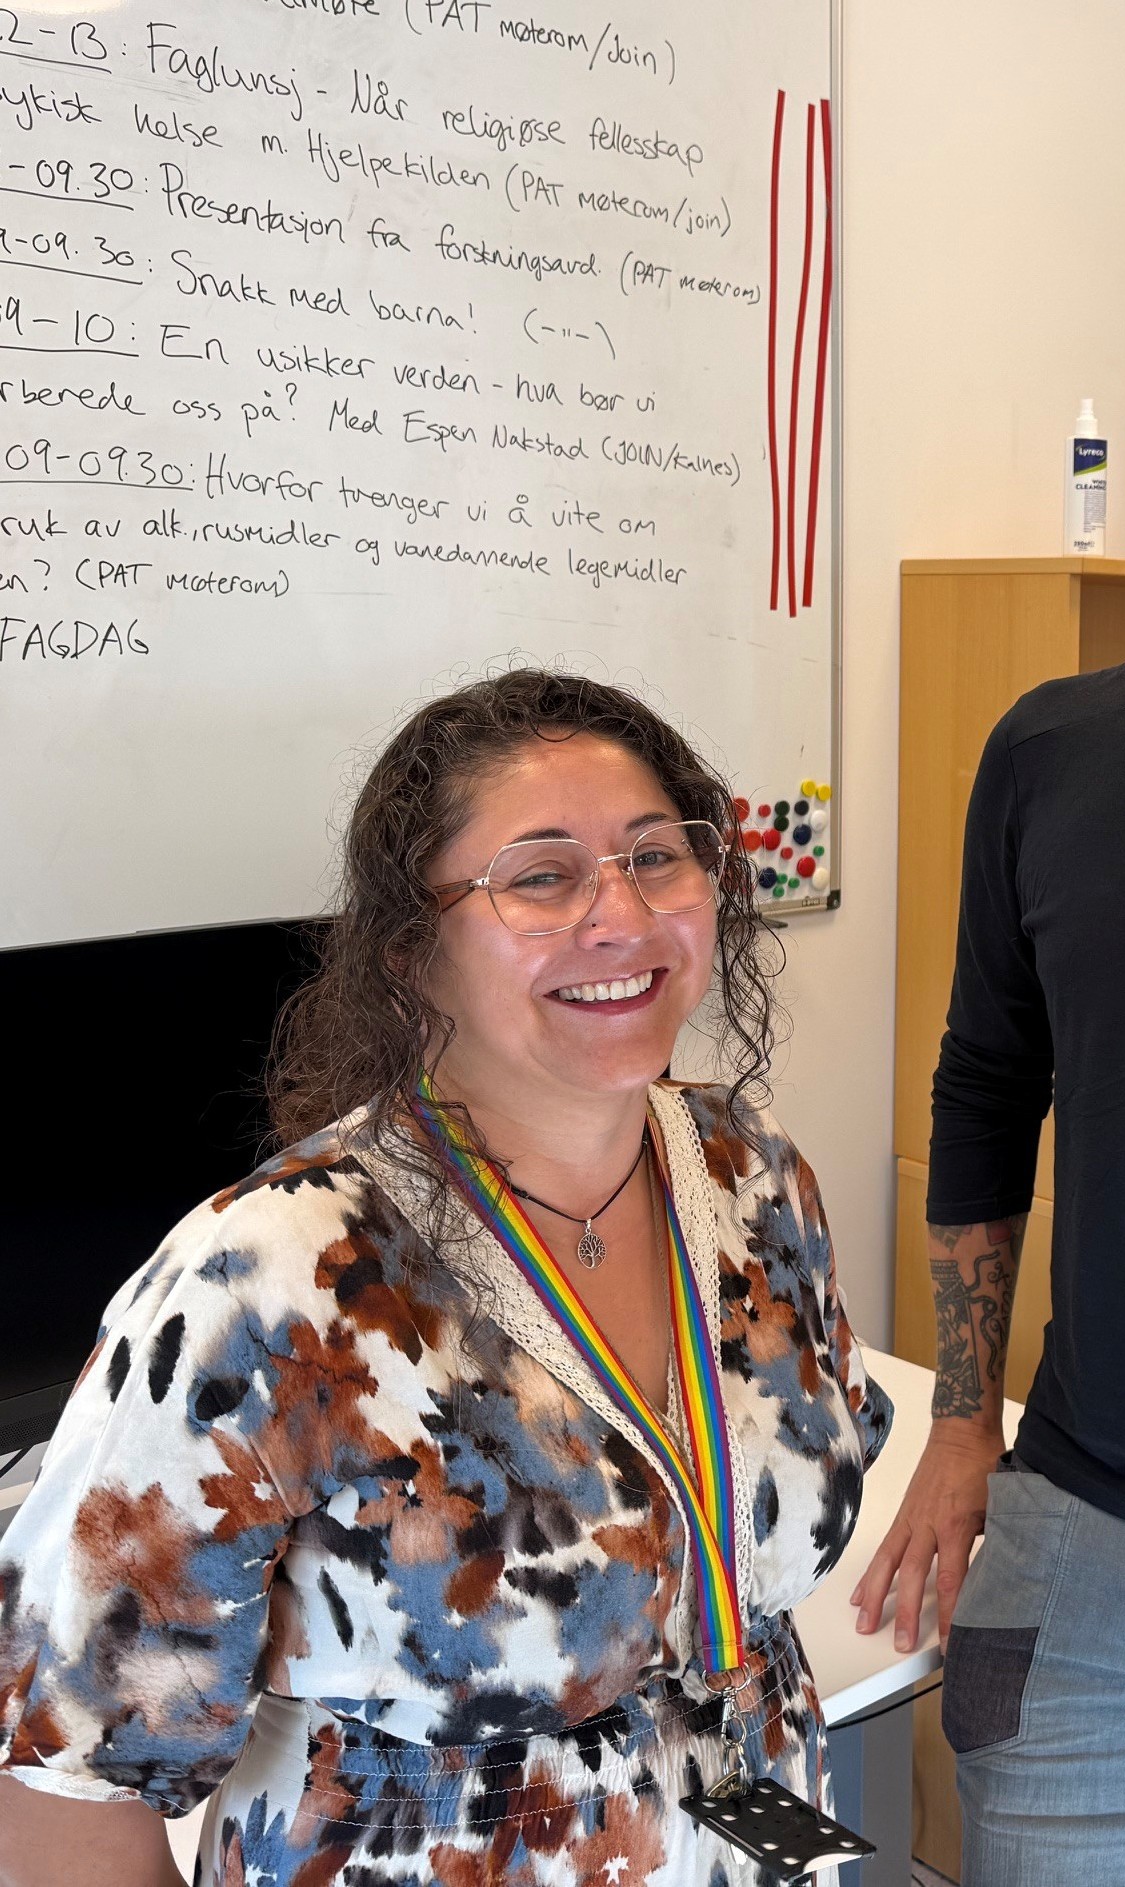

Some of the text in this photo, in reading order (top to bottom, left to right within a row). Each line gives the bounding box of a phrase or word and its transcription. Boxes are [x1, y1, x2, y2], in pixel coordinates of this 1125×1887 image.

[146, 22, 302, 121] Faglunsj
[351, 69, 408, 121] Når
[442, 105, 566, 152] religiøse
[589, 117, 703, 178] fellesskap
[0, 84, 102, 131] ykisk
[135, 104, 223, 148] helse
[262, 135, 288, 154] m.
[308, 128, 490, 190] Hjelpekilden
[505, 163, 564, 212] (PAT
[159, 162, 345, 244] Presentasjon
[366, 217, 411, 252] fra
[620, 251, 672, 296] (PAT
[171, 250, 276, 305] Snakk
[290, 288, 350, 316] med
[370, 290, 476, 334] barna!
[160, 324, 229, 365] En
[257, 345, 375, 379] usikker
[394, 365, 480, 394] verden
[517, 373, 563, 405] hva
[580, 383, 624, 411] bør
[637, 391, 655, 411] vi
[173, 400, 221, 421] oss
[241, 382, 297, 438] på?
[329, 397, 383, 435] Med
[403, 410, 477, 453] Espen
[492, 425, 589, 460] Nakstad
[206, 452, 323, 502] Hvorfor
[339, 476, 450, 524] trenger
[468, 501, 487, 522] vi
[508, 494, 532, 527] å
[552, 500, 604, 533] vite
[619, 519, 655, 536] om
[75, 558, 153, 590] (PAT
[85, 520, 121, 537] av
[355, 539, 379, 566] og
[395, 541, 550, 576] vanedannende
[569, 548, 687, 589] legemidler
[0, 616, 149, 662] FAGDAG
